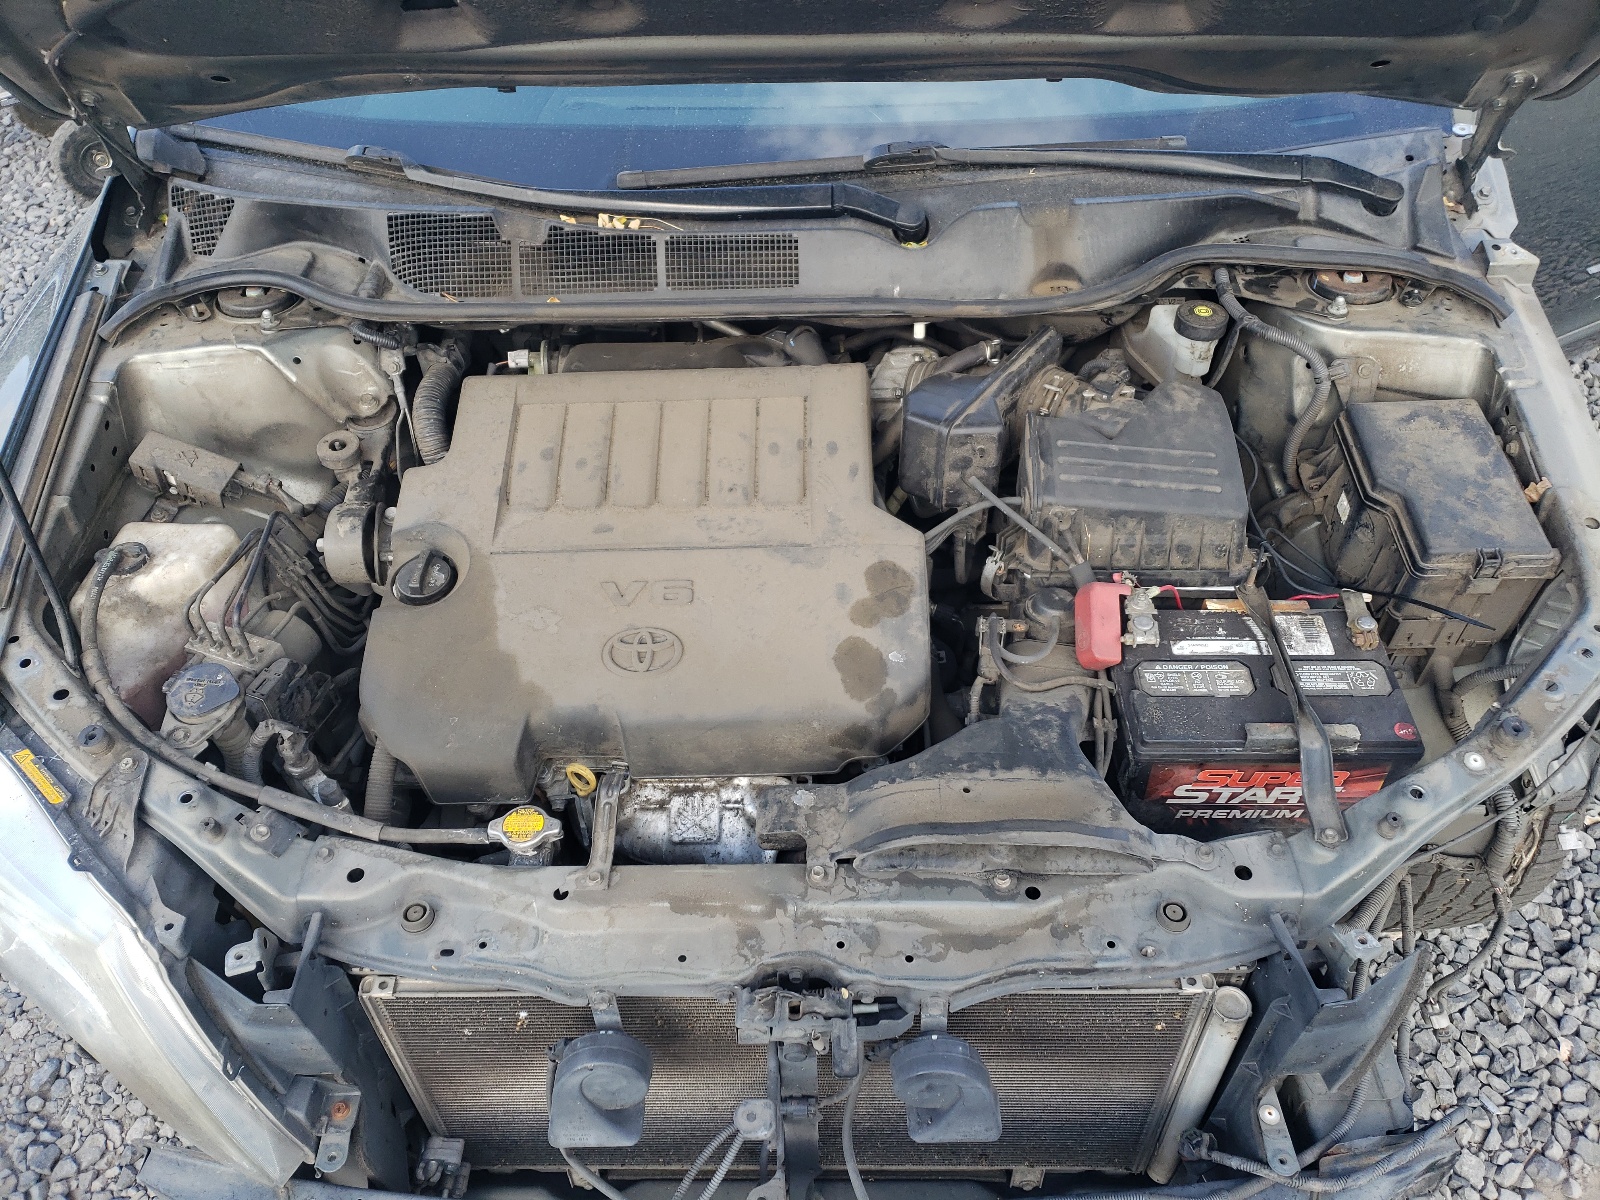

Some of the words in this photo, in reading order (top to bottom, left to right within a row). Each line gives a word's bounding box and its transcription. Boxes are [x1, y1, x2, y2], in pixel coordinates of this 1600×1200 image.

[600, 579, 694, 606] V6
[1166, 784, 1344, 803] STAR
[1175, 809, 1304, 819] PREMIUM
